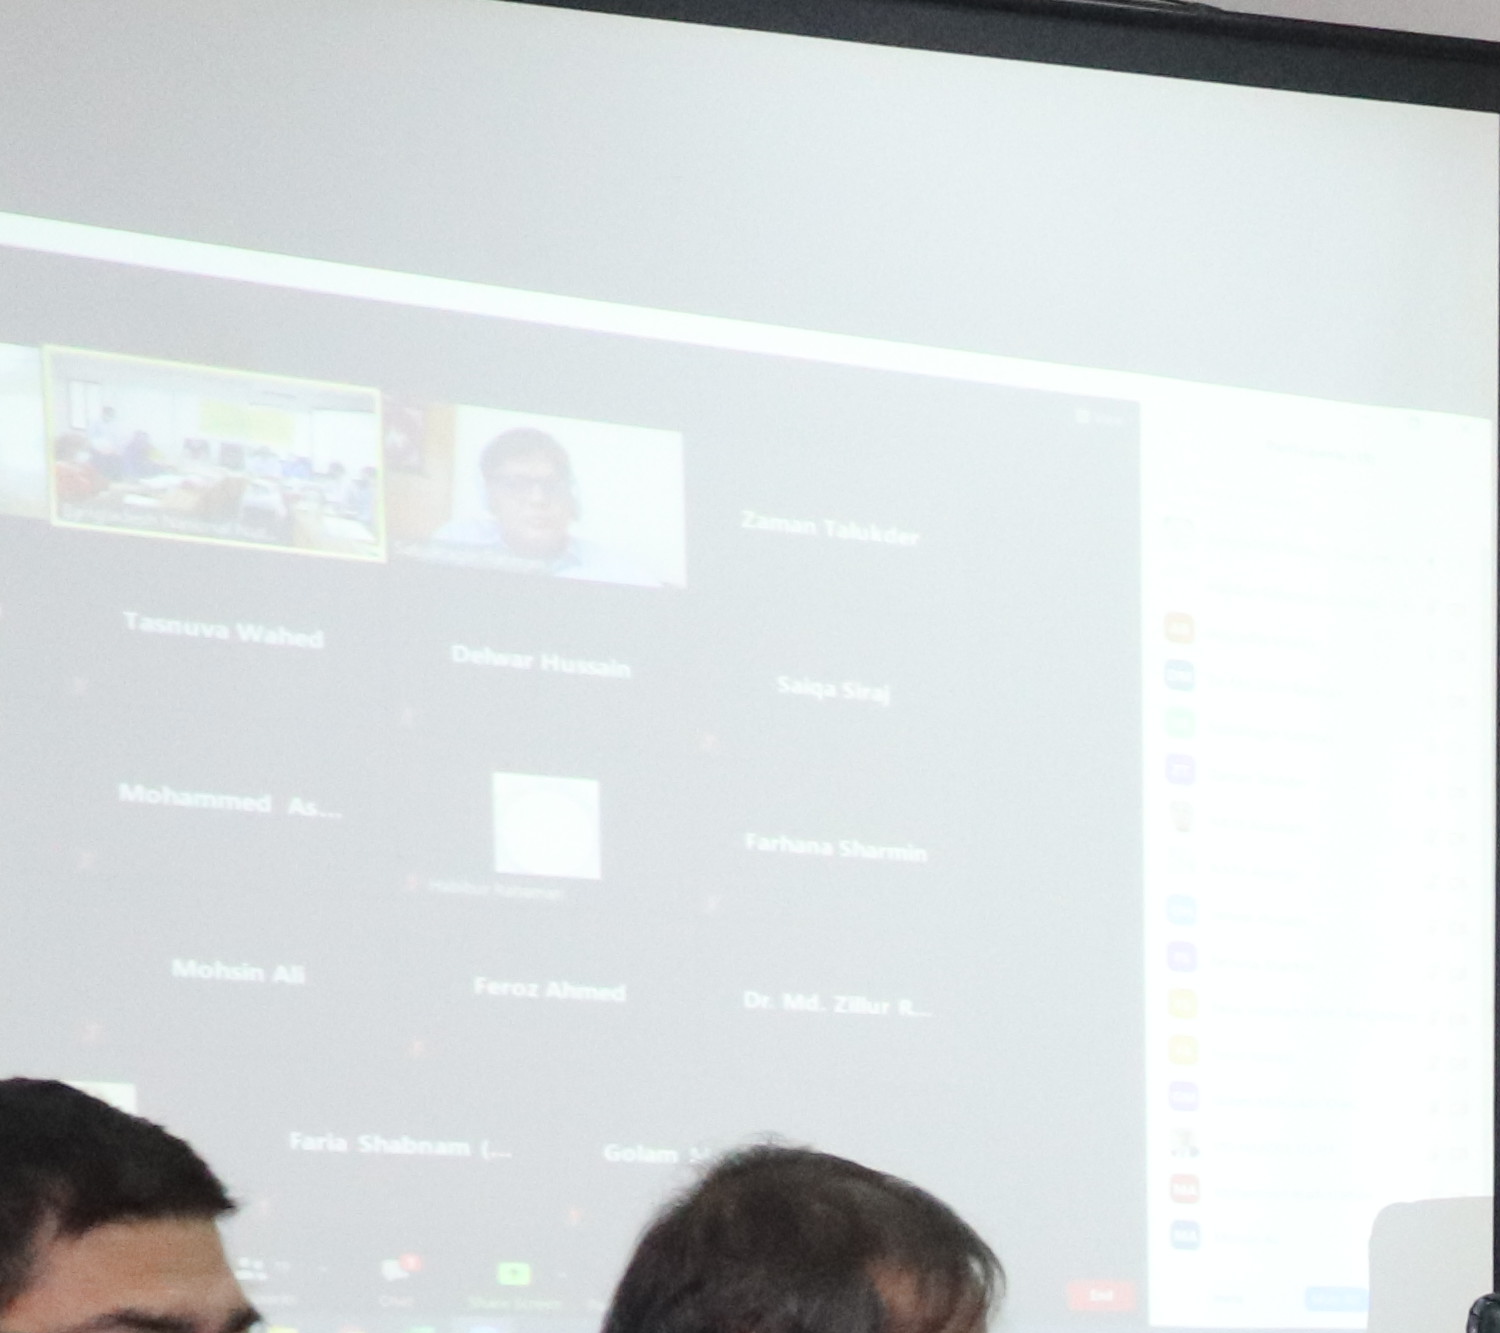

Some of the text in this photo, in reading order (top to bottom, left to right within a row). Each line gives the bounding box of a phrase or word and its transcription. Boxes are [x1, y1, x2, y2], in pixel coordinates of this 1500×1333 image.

[741, 510, 817, 536] Zaman
[122, 610, 230, 641] Tasnuva
[119, 783, 272, 816] Mohammed
[172, 958, 265, 984] Mohsin
[473, 976, 627, 1004] Feroz Ahmed
